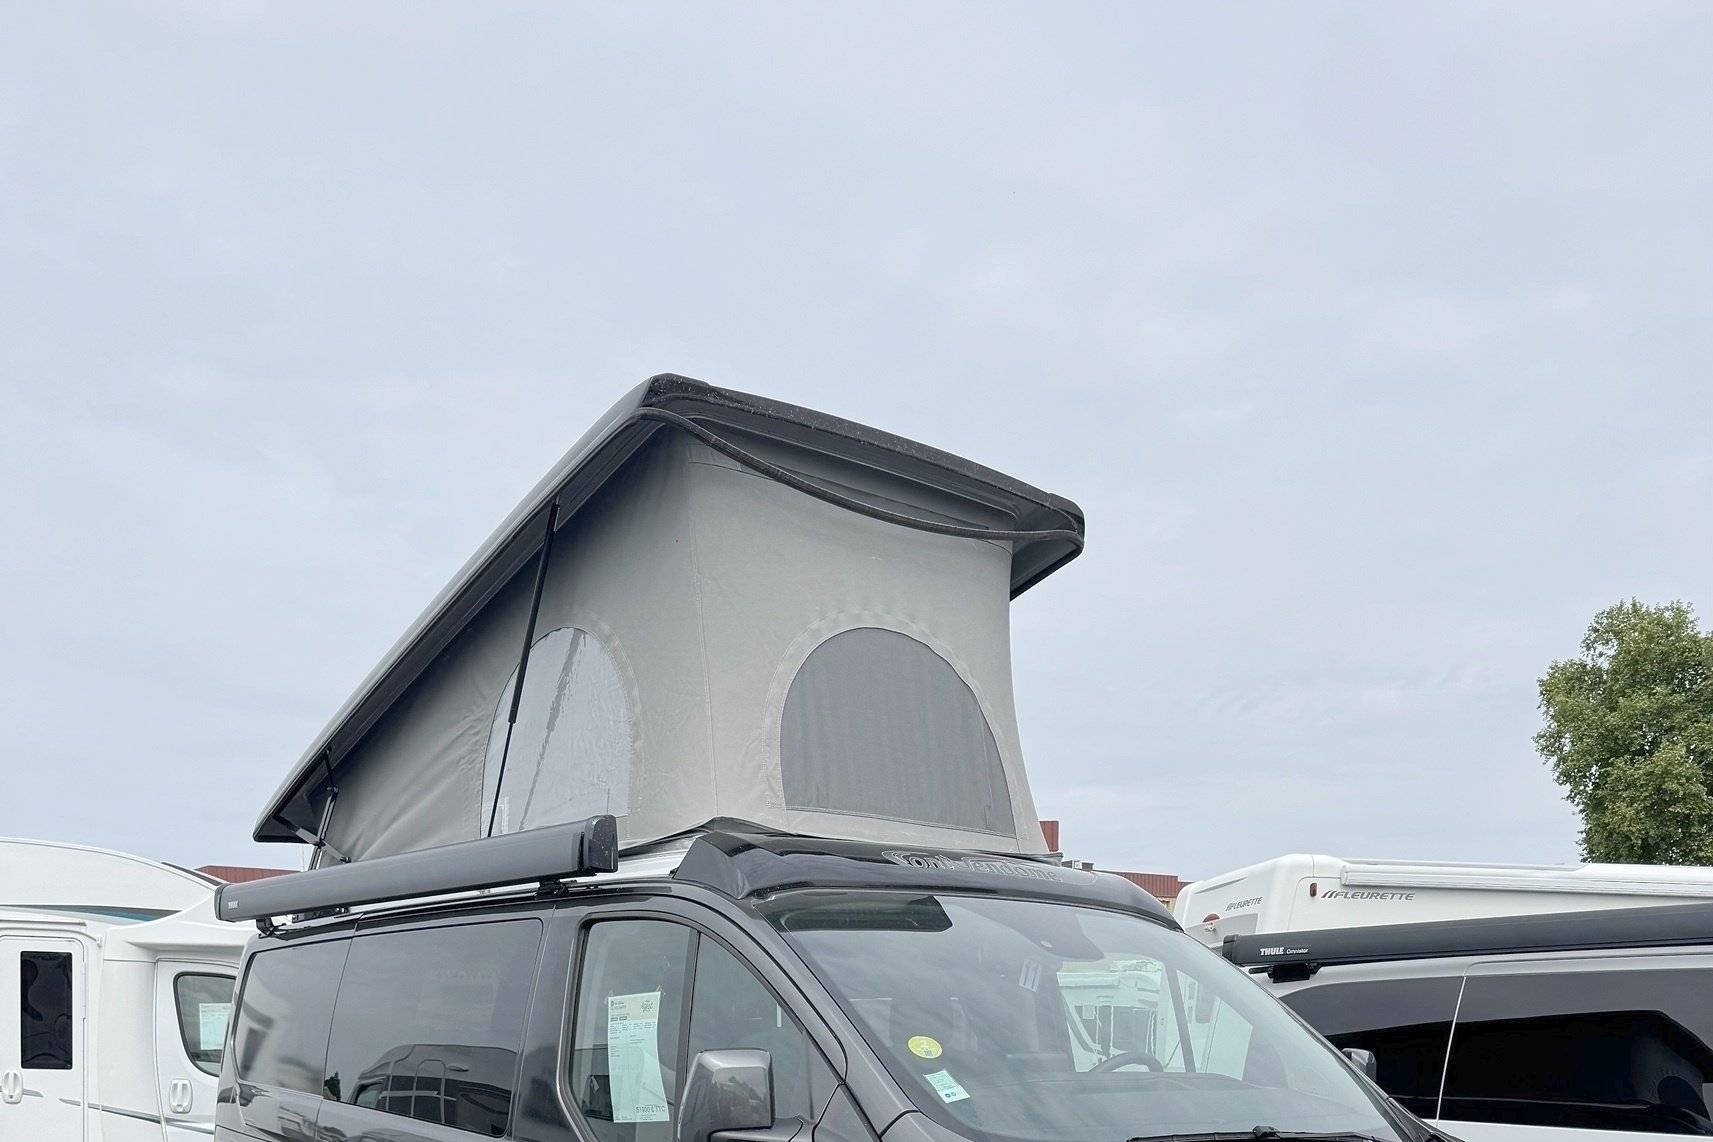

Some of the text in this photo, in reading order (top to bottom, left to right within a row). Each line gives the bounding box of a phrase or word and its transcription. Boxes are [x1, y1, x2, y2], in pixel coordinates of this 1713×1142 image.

[1333, 891, 1416, 901] FLEURETTE
[1230, 897, 1262, 910] FLEURETTE
[1260, 947, 1284, 956] THULE
